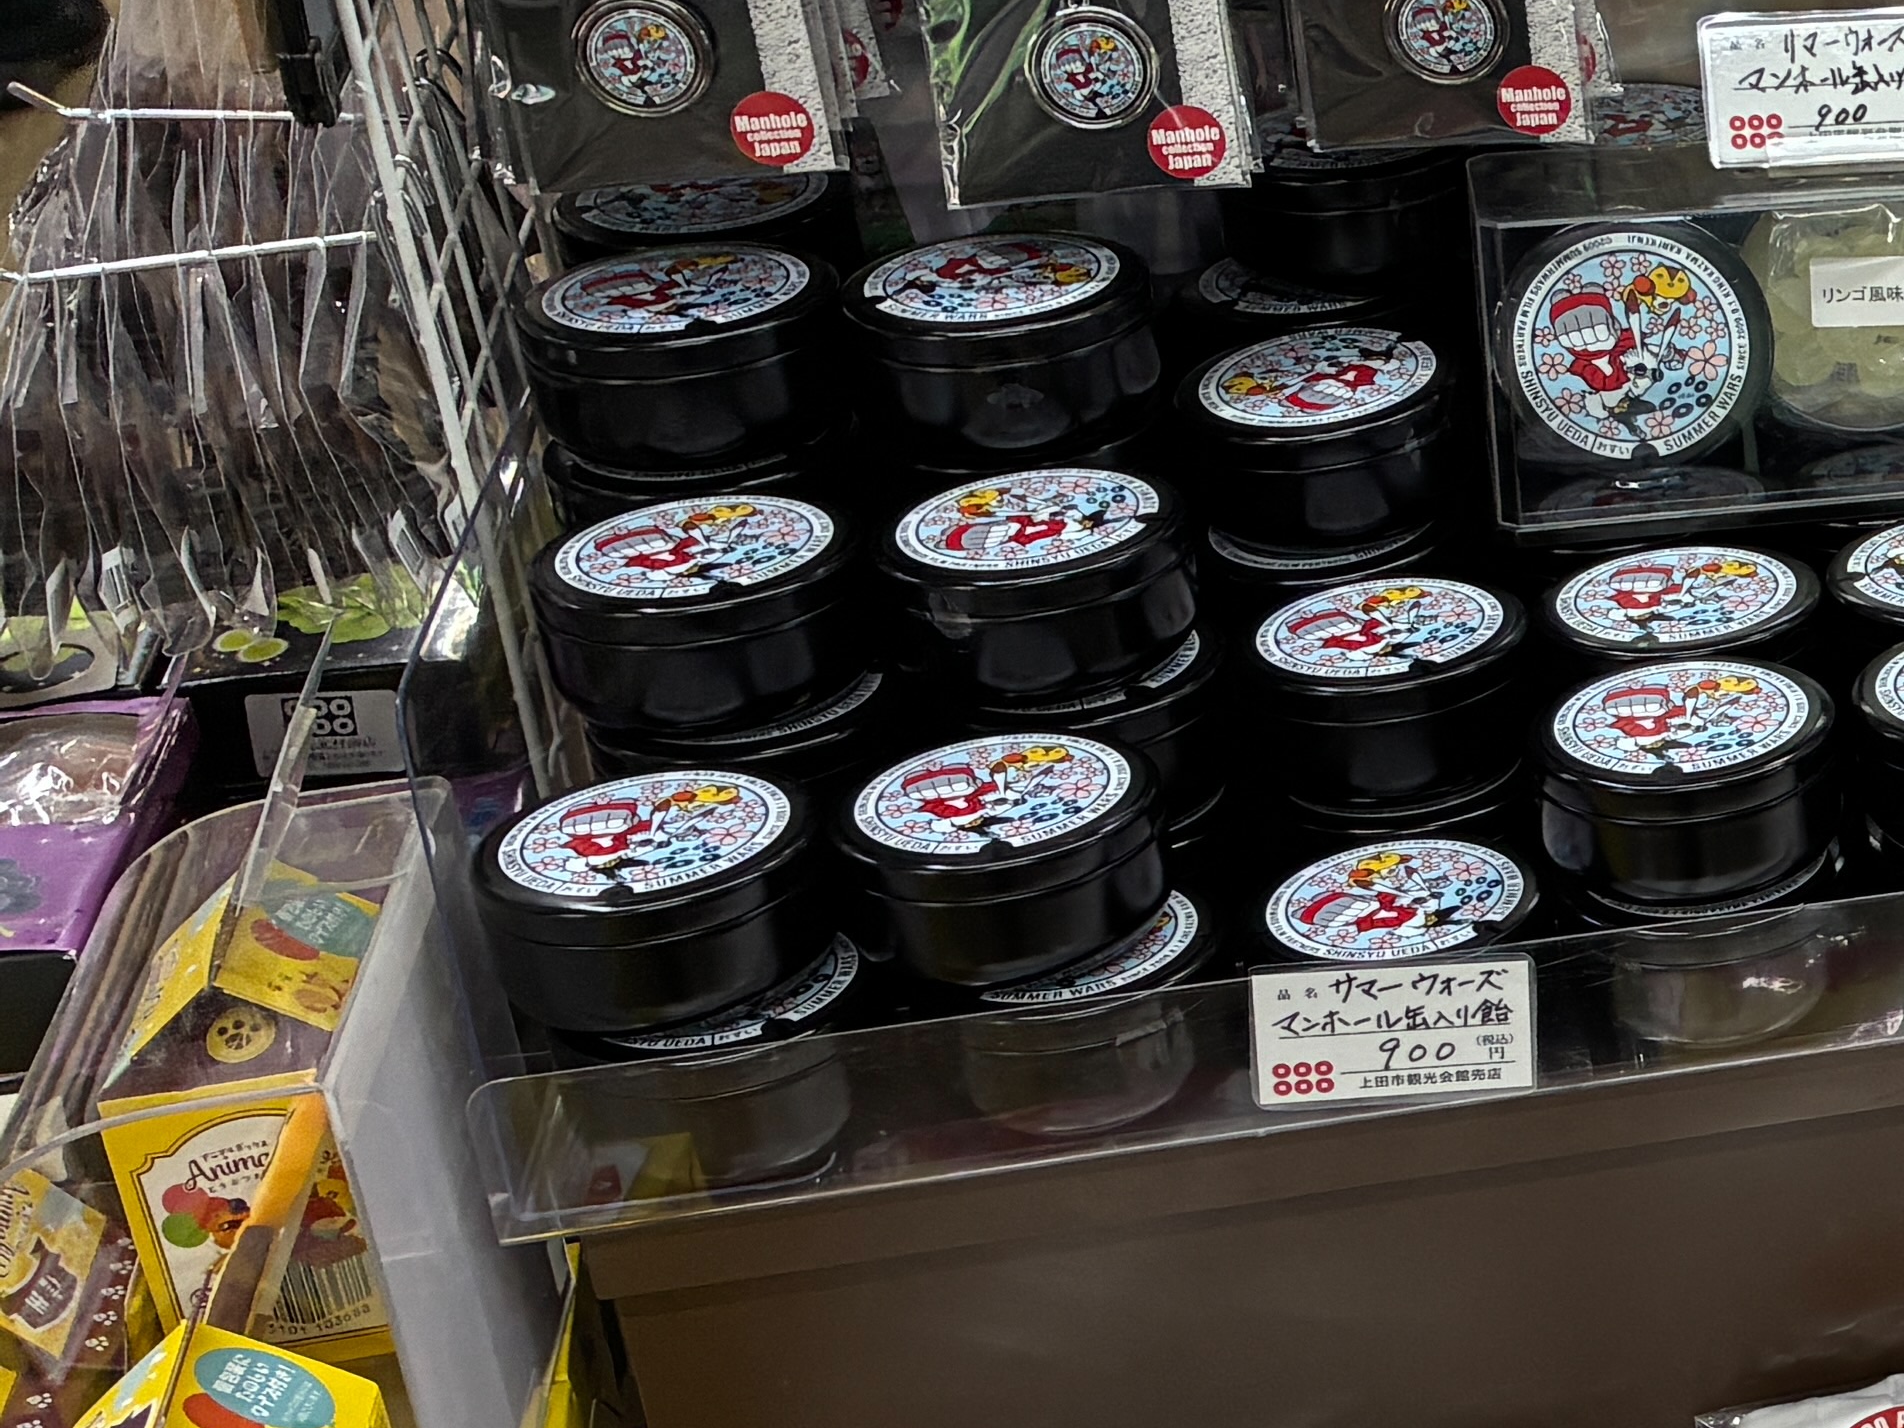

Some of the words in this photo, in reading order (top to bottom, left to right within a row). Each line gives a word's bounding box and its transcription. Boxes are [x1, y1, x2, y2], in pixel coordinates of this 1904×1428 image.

[1499, 84, 1568, 105] Manhole
[734, 109, 808, 134] Manhole
[1514, 109, 1559, 130] Japan
[1816, 103, 1867, 132] 900
[752, 139, 803, 158] Japan
[1151, 126, 1221, 149] Manhole
[1167, 150, 1213, 172] Japan
[1522, 369, 1558, 423] SHINSYU
[1556, 415, 1589, 447] UEDA
[1663, 406, 1718, 452] SUMMER
[1716, 373, 1741, 416] WARS
[1019, 818, 1088, 846] SUMMER
[644, 862, 719, 891] SUMMER
[1278, 988, 1318, 1000] 品名
[1329, 968, 1509, 1003] サマーウォーズ
[1272, 998, 1513, 1036] マンホール缶入り飴
[1379, 1038, 1456, 1070] 900
[1489, 1046, 1504, 1060] 円
[1360, 1068, 1502, 1089] 上田市観光会館売店
